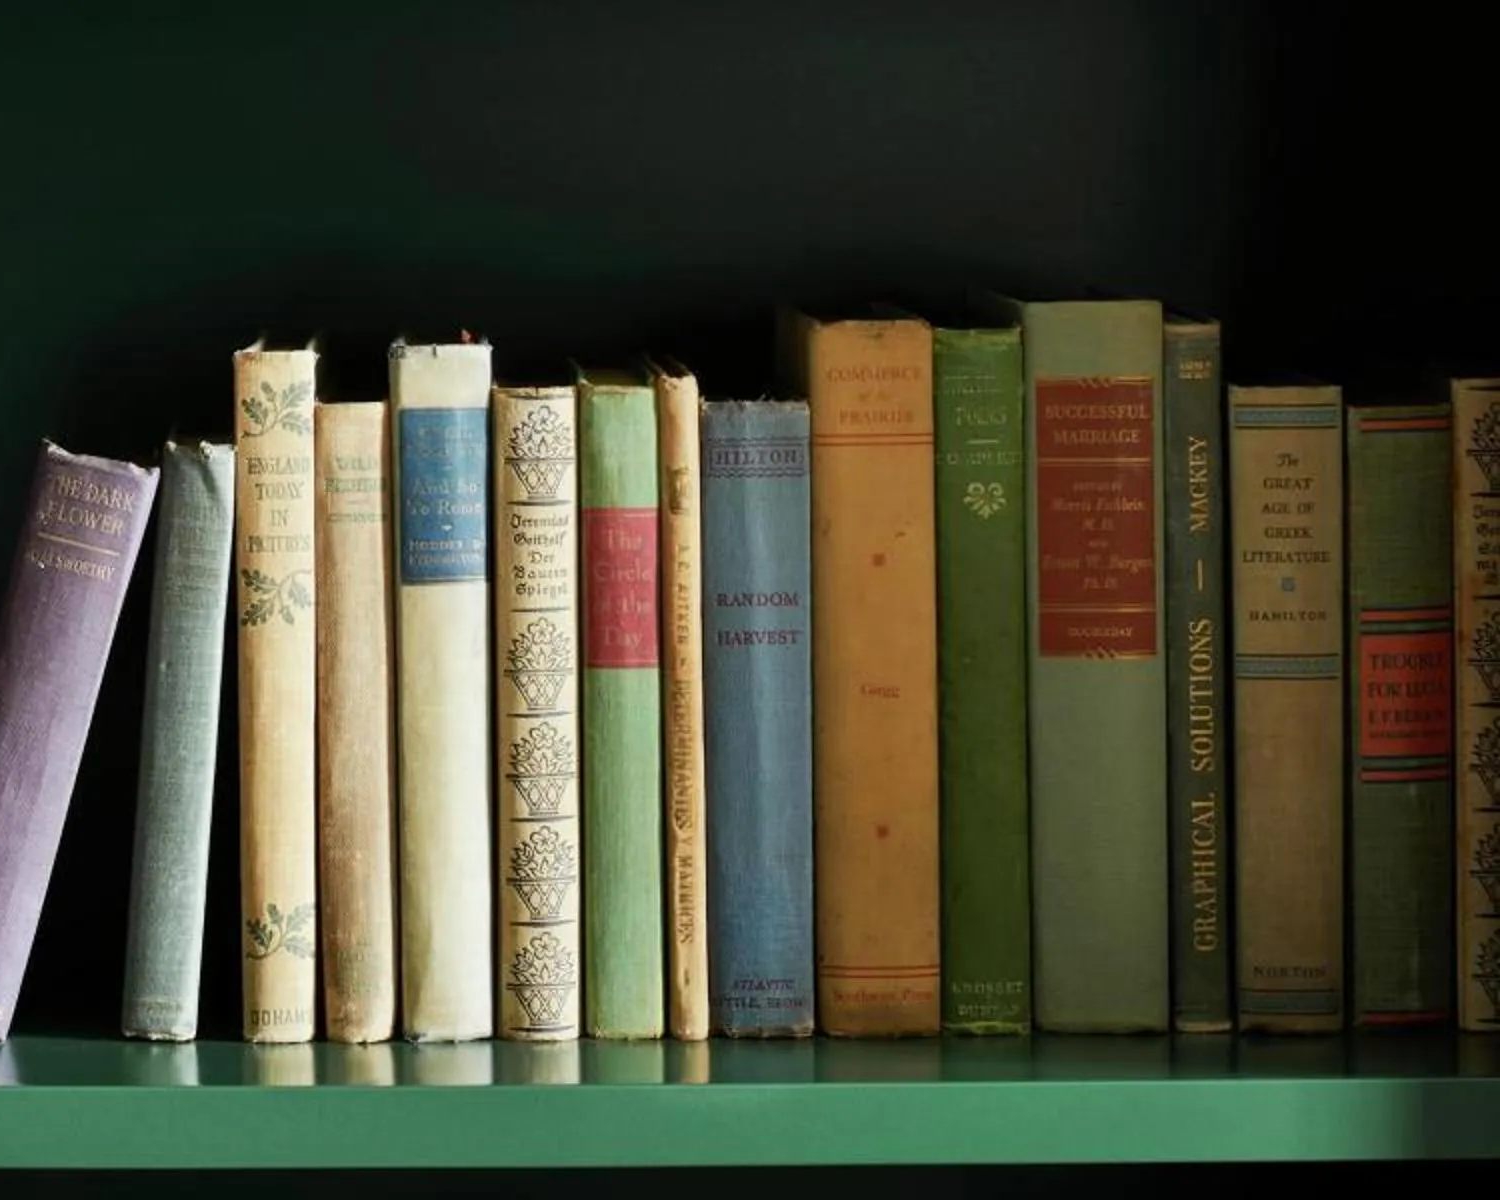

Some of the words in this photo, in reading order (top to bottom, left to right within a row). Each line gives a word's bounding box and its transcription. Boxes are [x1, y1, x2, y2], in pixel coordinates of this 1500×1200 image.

[1045, 405, 1149, 420] SUCCESSFUL
[1052, 429, 1140, 444] MARRIAGE
[714, 450, 798, 466] HILTON
[1275, 453, 1300, 468] The
[246, 457, 310, 476] ENGLAND
[254, 481, 304, 500] TODAY
[1188, 436, 1209, 534] MACKEY
[1262, 477, 1314, 490] GREAT
[49, 473, 82, 501] THE
[85, 482, 134, 513] DARK
[1261, 502, 1289, 515] AGE
[46, 500, 126, 537] FLOWER
[269, 508, 289, 527] IN
[1264, 526, 1313, 540] GREEK
[1242, 550, 1331, 564] LITERATURE
[716, 592, 799, 607] RANDOM
[1249, 610, 1328, 622] HAMILTON
[716, 630, 800, 646] HARVEST
[1188, 616, 1214, 772] SOLUTIONS
[1190, 792, 1217, 952] GRAPHICAL
